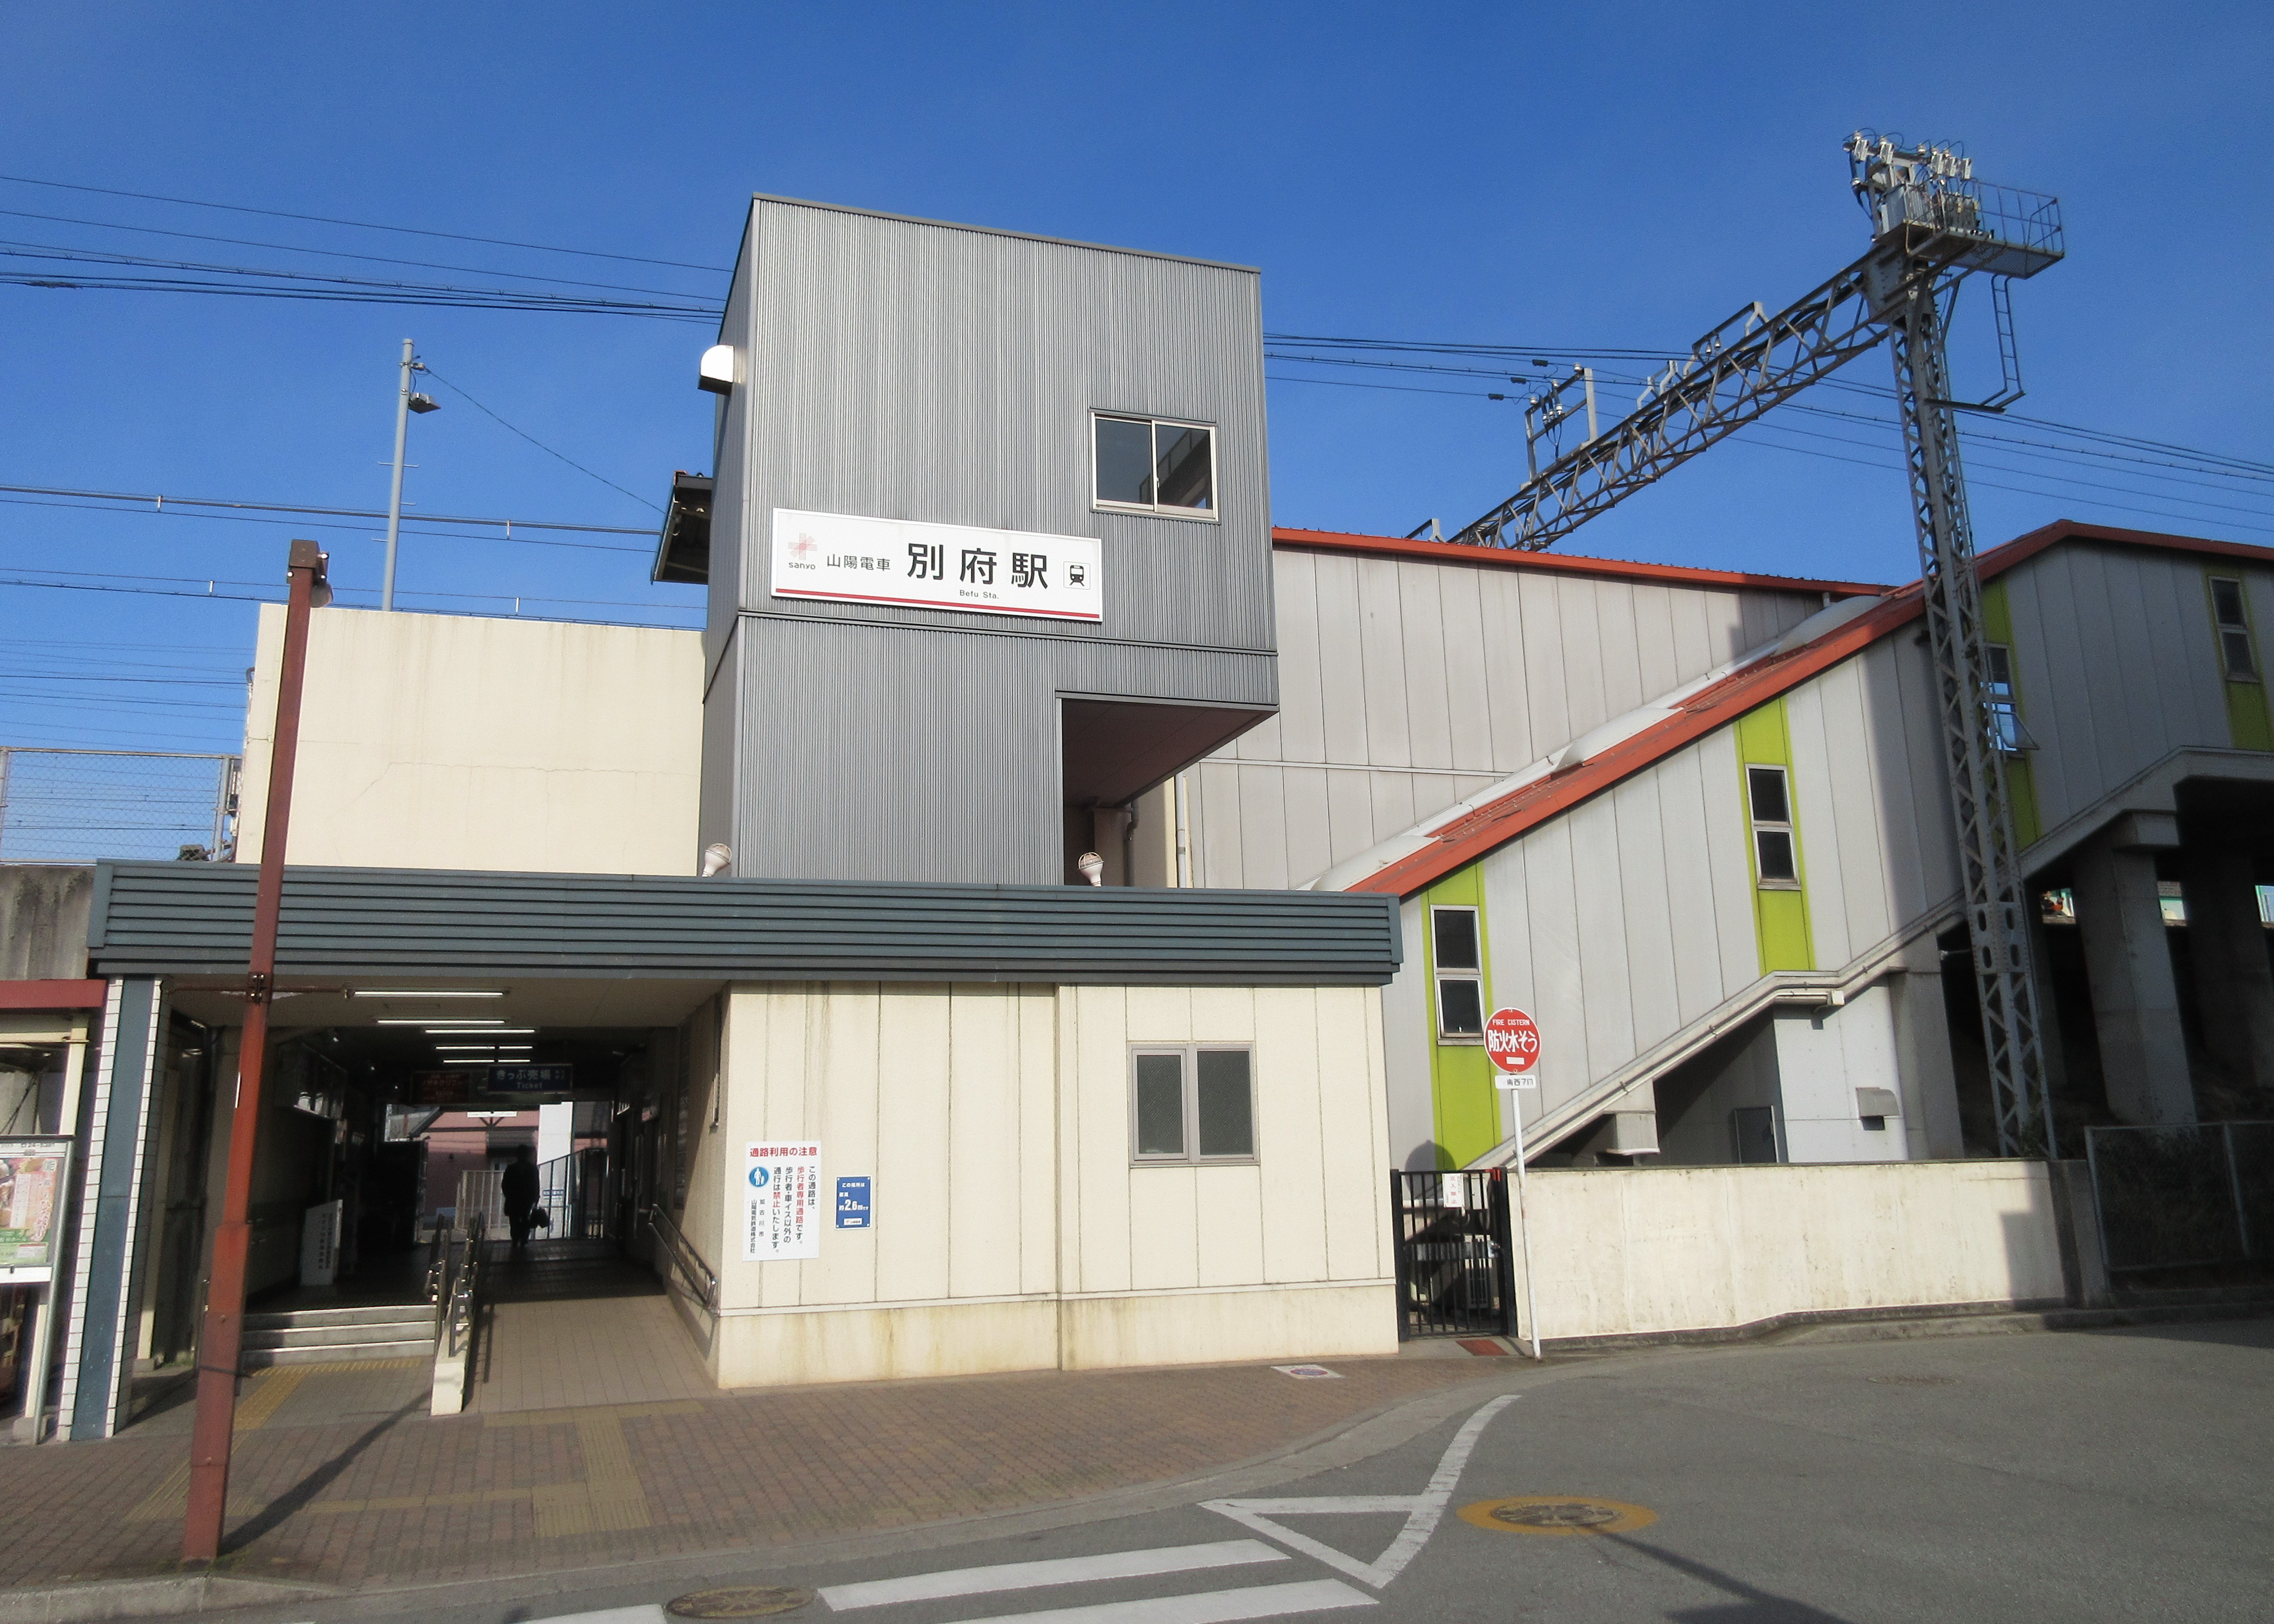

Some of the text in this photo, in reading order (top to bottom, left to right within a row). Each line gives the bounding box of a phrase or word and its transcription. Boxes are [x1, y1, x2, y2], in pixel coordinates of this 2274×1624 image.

[788, 562, 816, 570] sanyo
[826, 553, 891, 571] 山陽電車
[907, 542, 1049, 589] 別府駅
[959, 589, 1000, 600] Befu Sta.
[1487, 1029, 1538, 1053] 防火水そう
[749, 1147, 818, 1157] 通路利用の注意
[772, 1167, 781, 1252] 通行は禁止いたします。
[784, 1167, 793, 1243] 歩行者・車イス以外の
[796, 1167, 805, 1244] 歩行者専用通路です。
